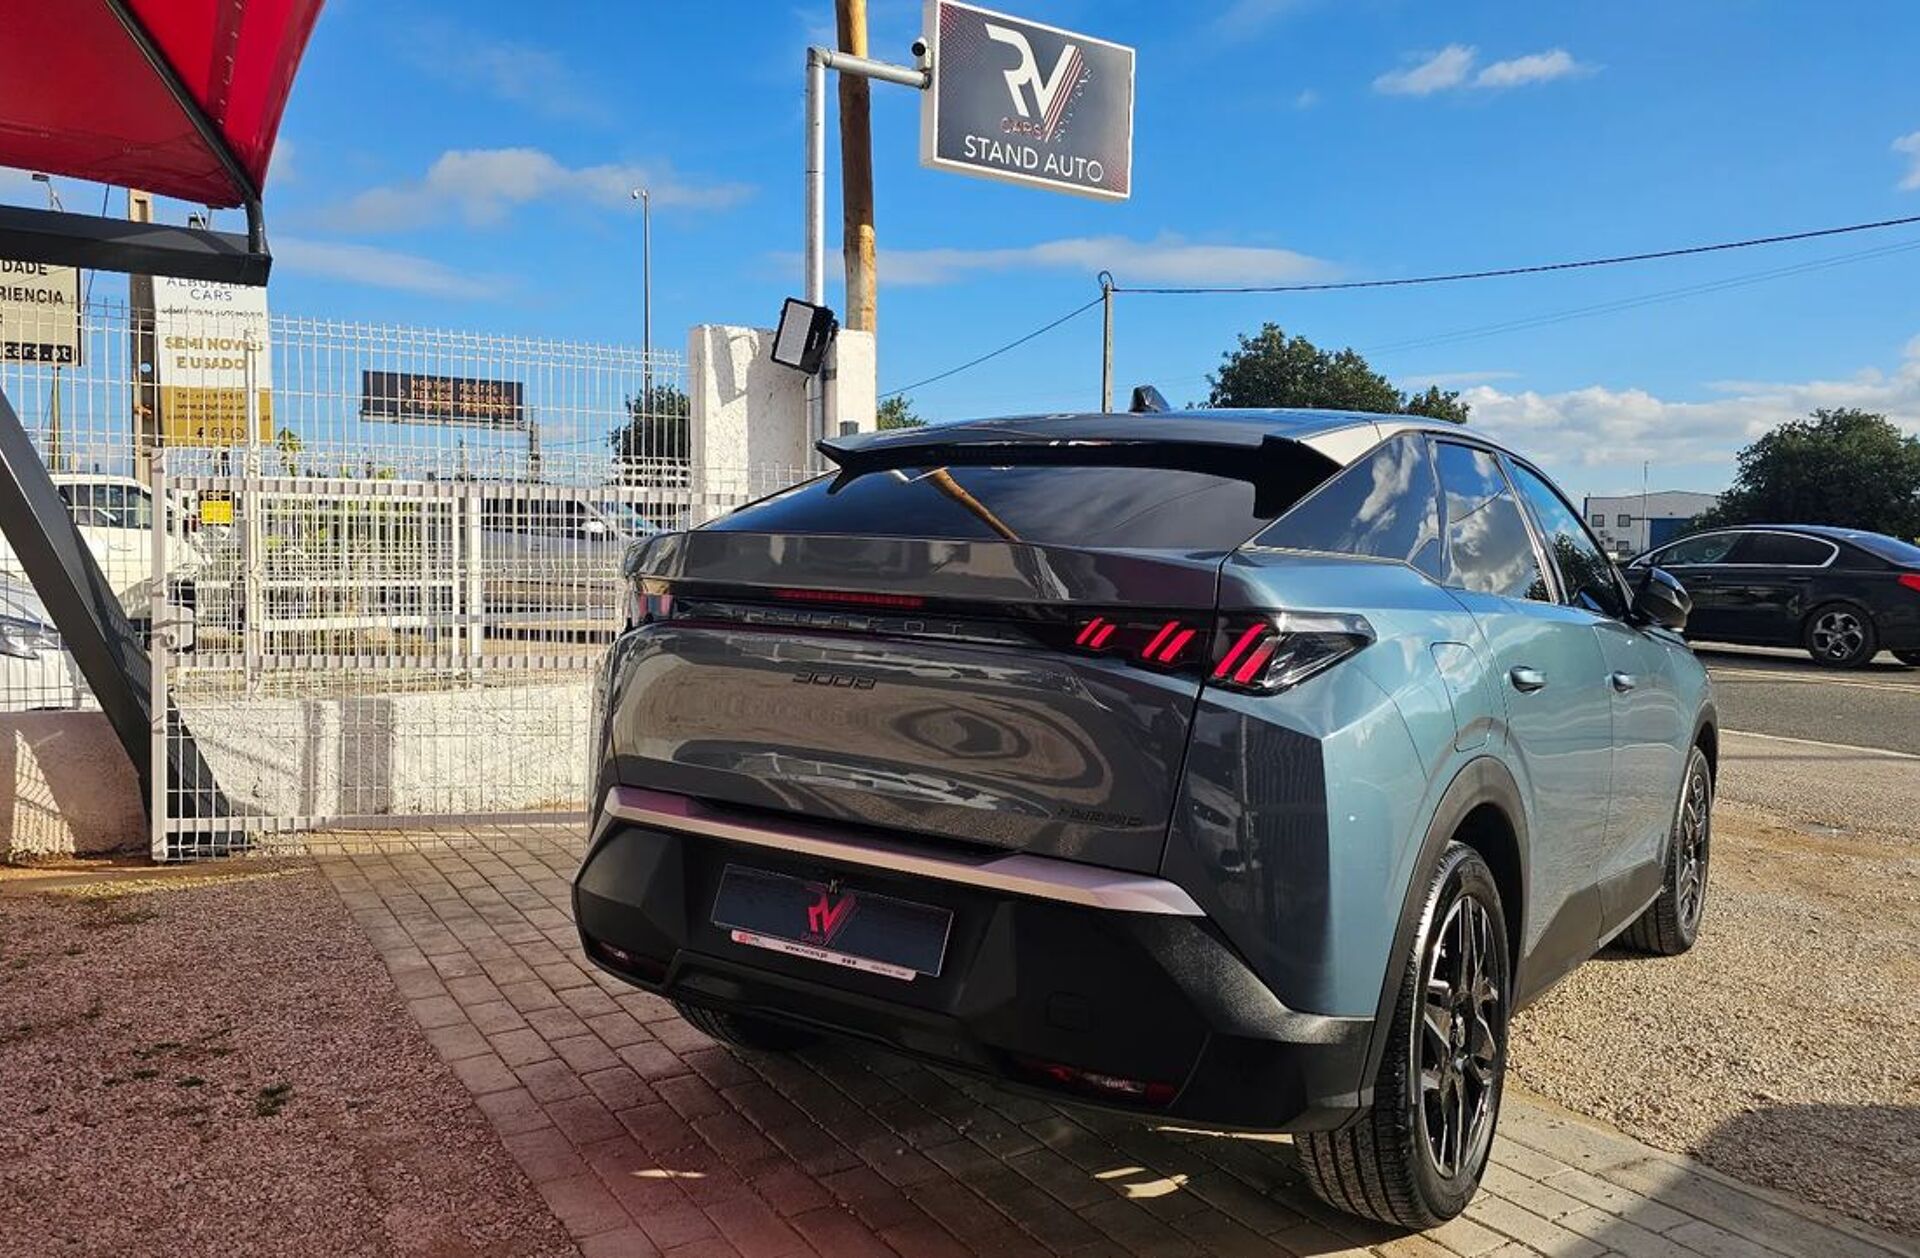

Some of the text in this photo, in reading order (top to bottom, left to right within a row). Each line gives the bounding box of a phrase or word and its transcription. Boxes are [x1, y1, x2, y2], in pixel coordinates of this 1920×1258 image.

[964, 135, 1104, 182] STAND AUTO
[190, 288, 233, 301] CARS
[165, 336, 203, 350] SEMI
[792, 671, 877, 690] 3008
